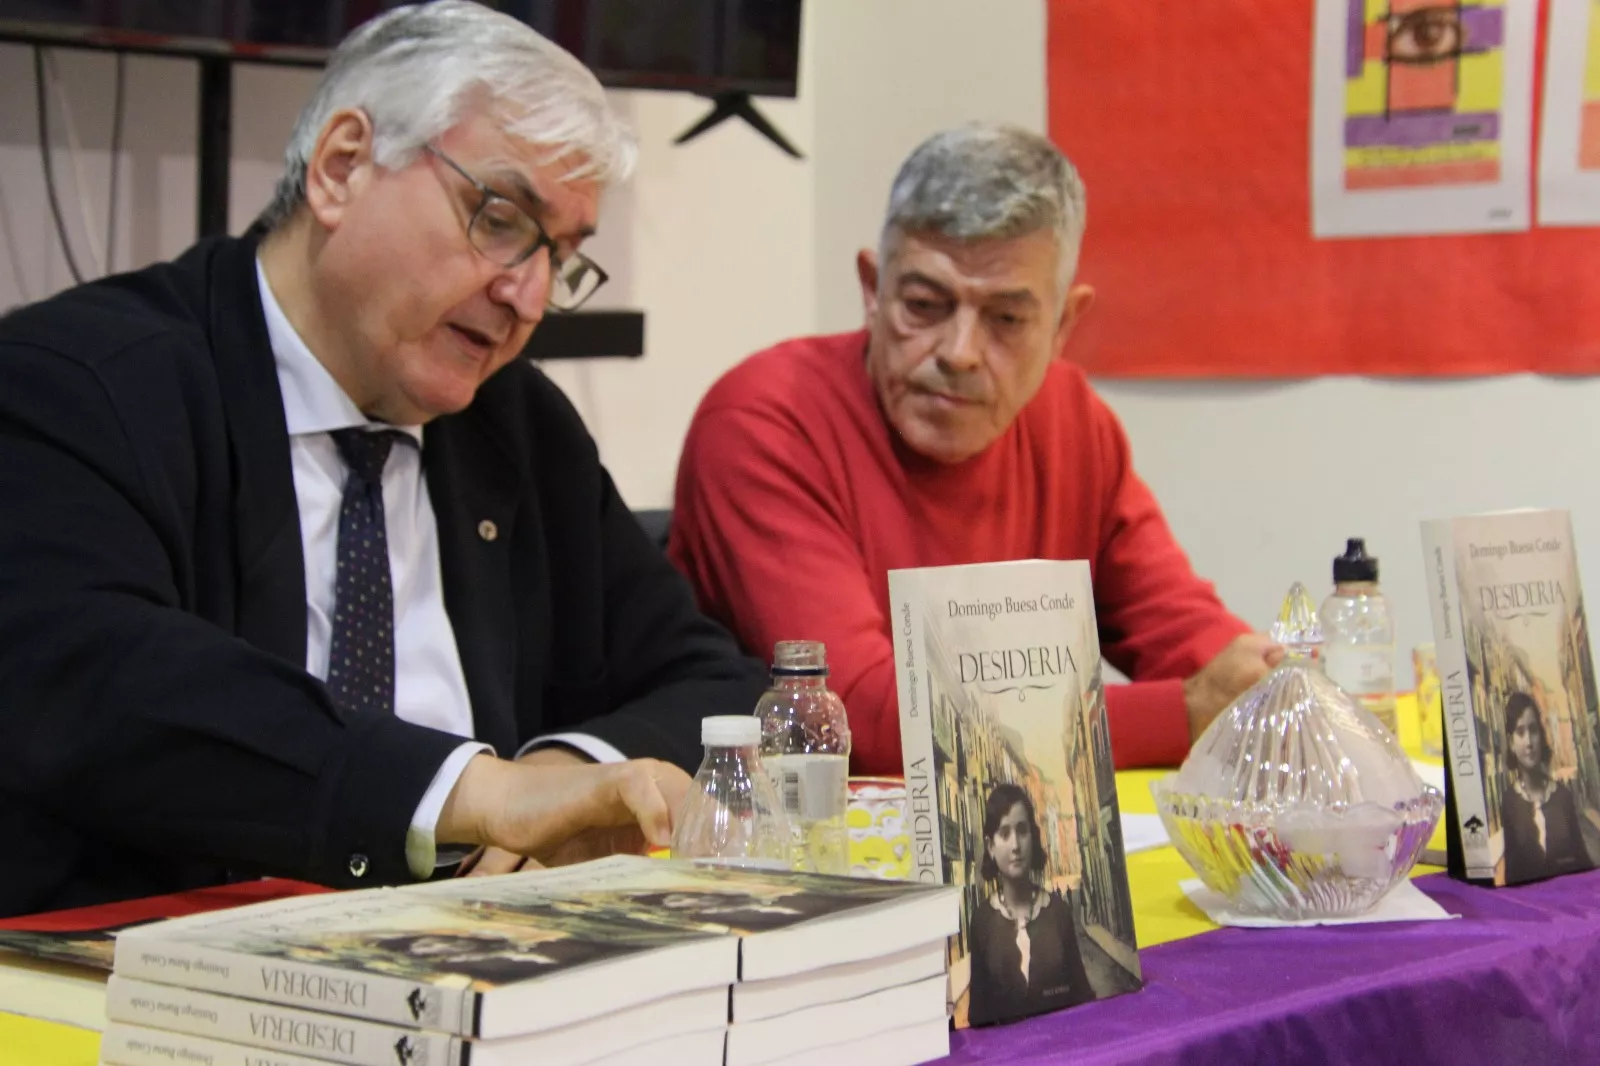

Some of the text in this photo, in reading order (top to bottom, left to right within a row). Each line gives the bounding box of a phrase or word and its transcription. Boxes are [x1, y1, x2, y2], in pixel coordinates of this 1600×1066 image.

[1469, 543, 1508, 561] Domingo
[948, 593, 1075, 621] Domingo Buesa Conde
[1479, 580, 1566, 612] DESIDERIA
[902, 602, 919, 718] Domingo Buesa Conde
[958, 645, 1078, 684] DESIDERIA
[1447, 670, 1474, 776] DESIDERIA
[261, 964, 367, 1008] DESIDERIA
[249, 1011, 355, 1055] DESIDERIA
